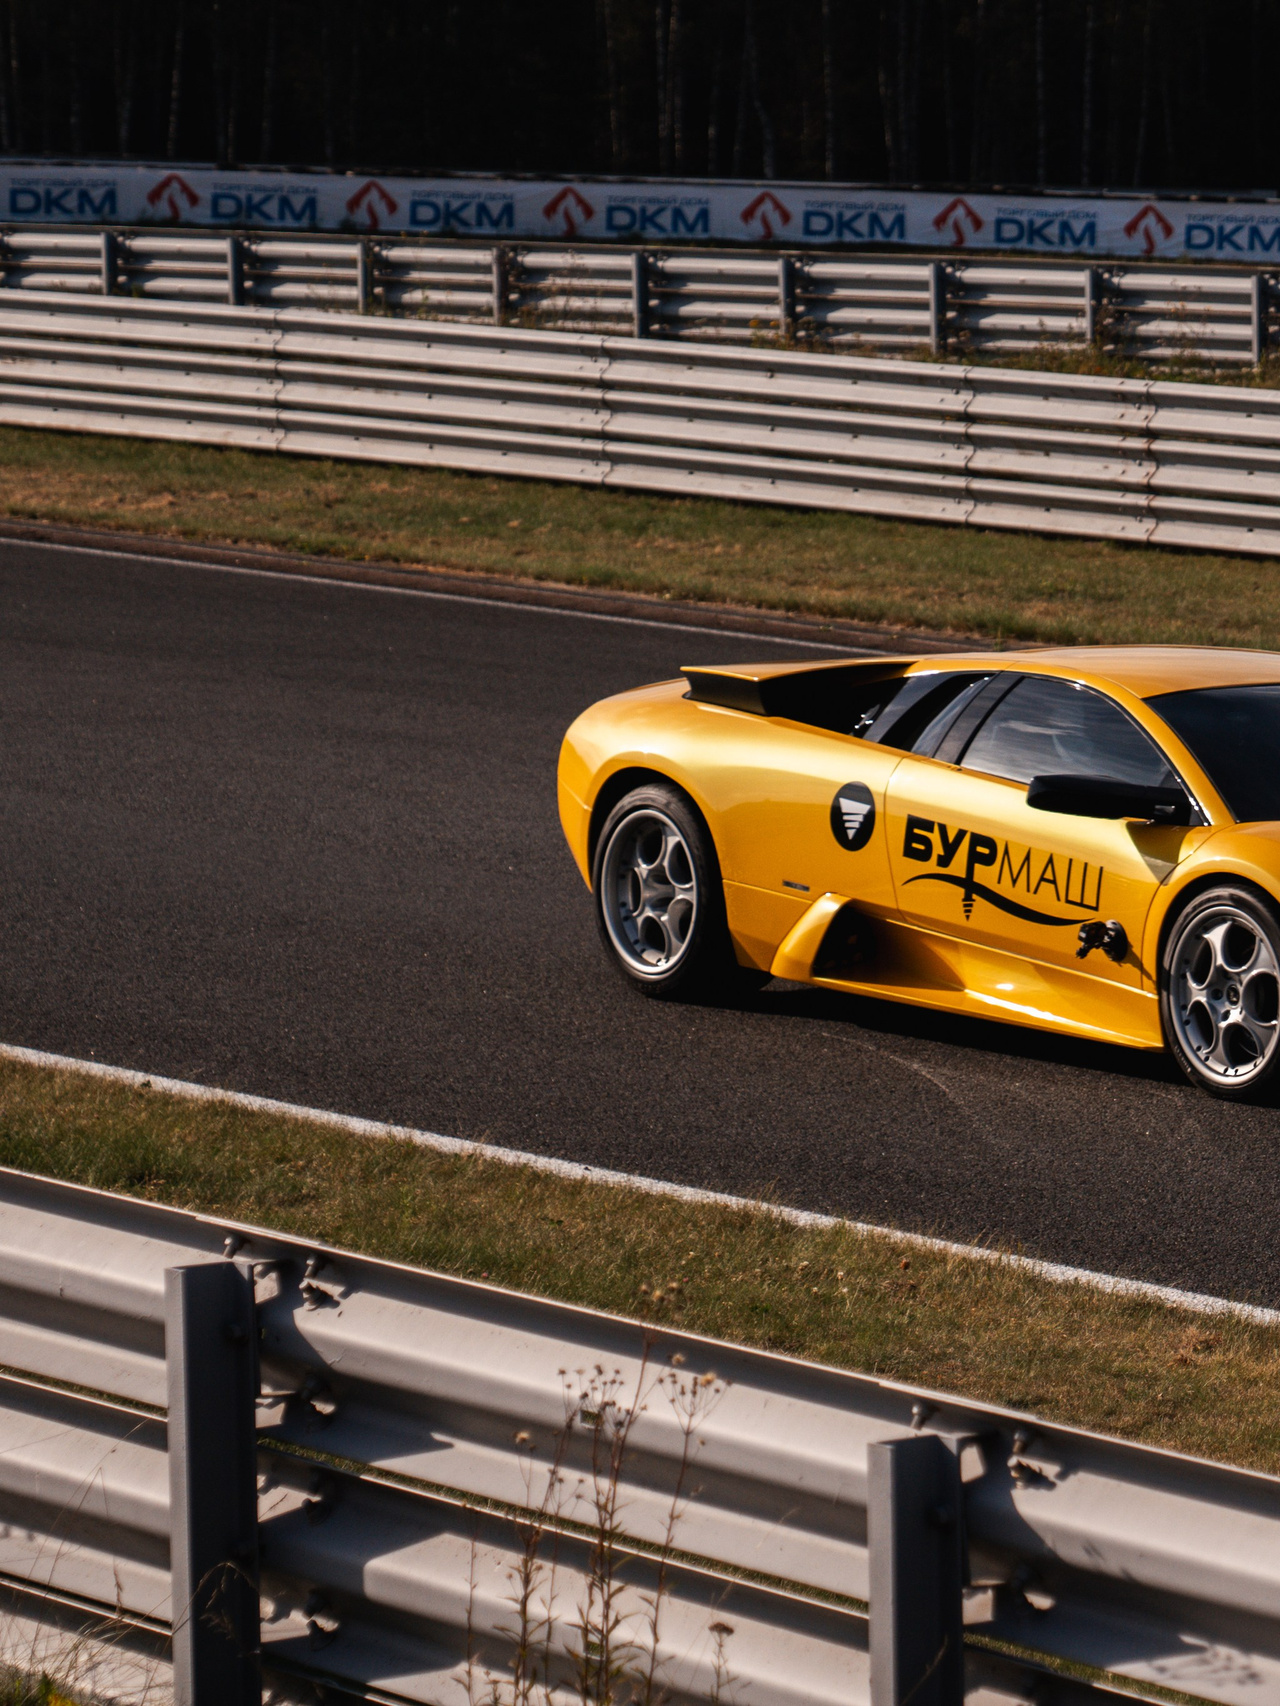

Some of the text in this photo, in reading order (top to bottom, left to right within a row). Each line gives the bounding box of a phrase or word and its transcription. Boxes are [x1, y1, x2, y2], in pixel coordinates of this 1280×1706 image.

[9, 187, 117, 215] DKM
[211, 192, 317, 221] DKM
[409, 199, 514, 227] DKM
[605, 205, 709, 234] DKM
[802, 210, 905, 239] DKM
[994, 217, 1096, 246] DKM
[903, 814, 1103, 913] БУРМАШ
